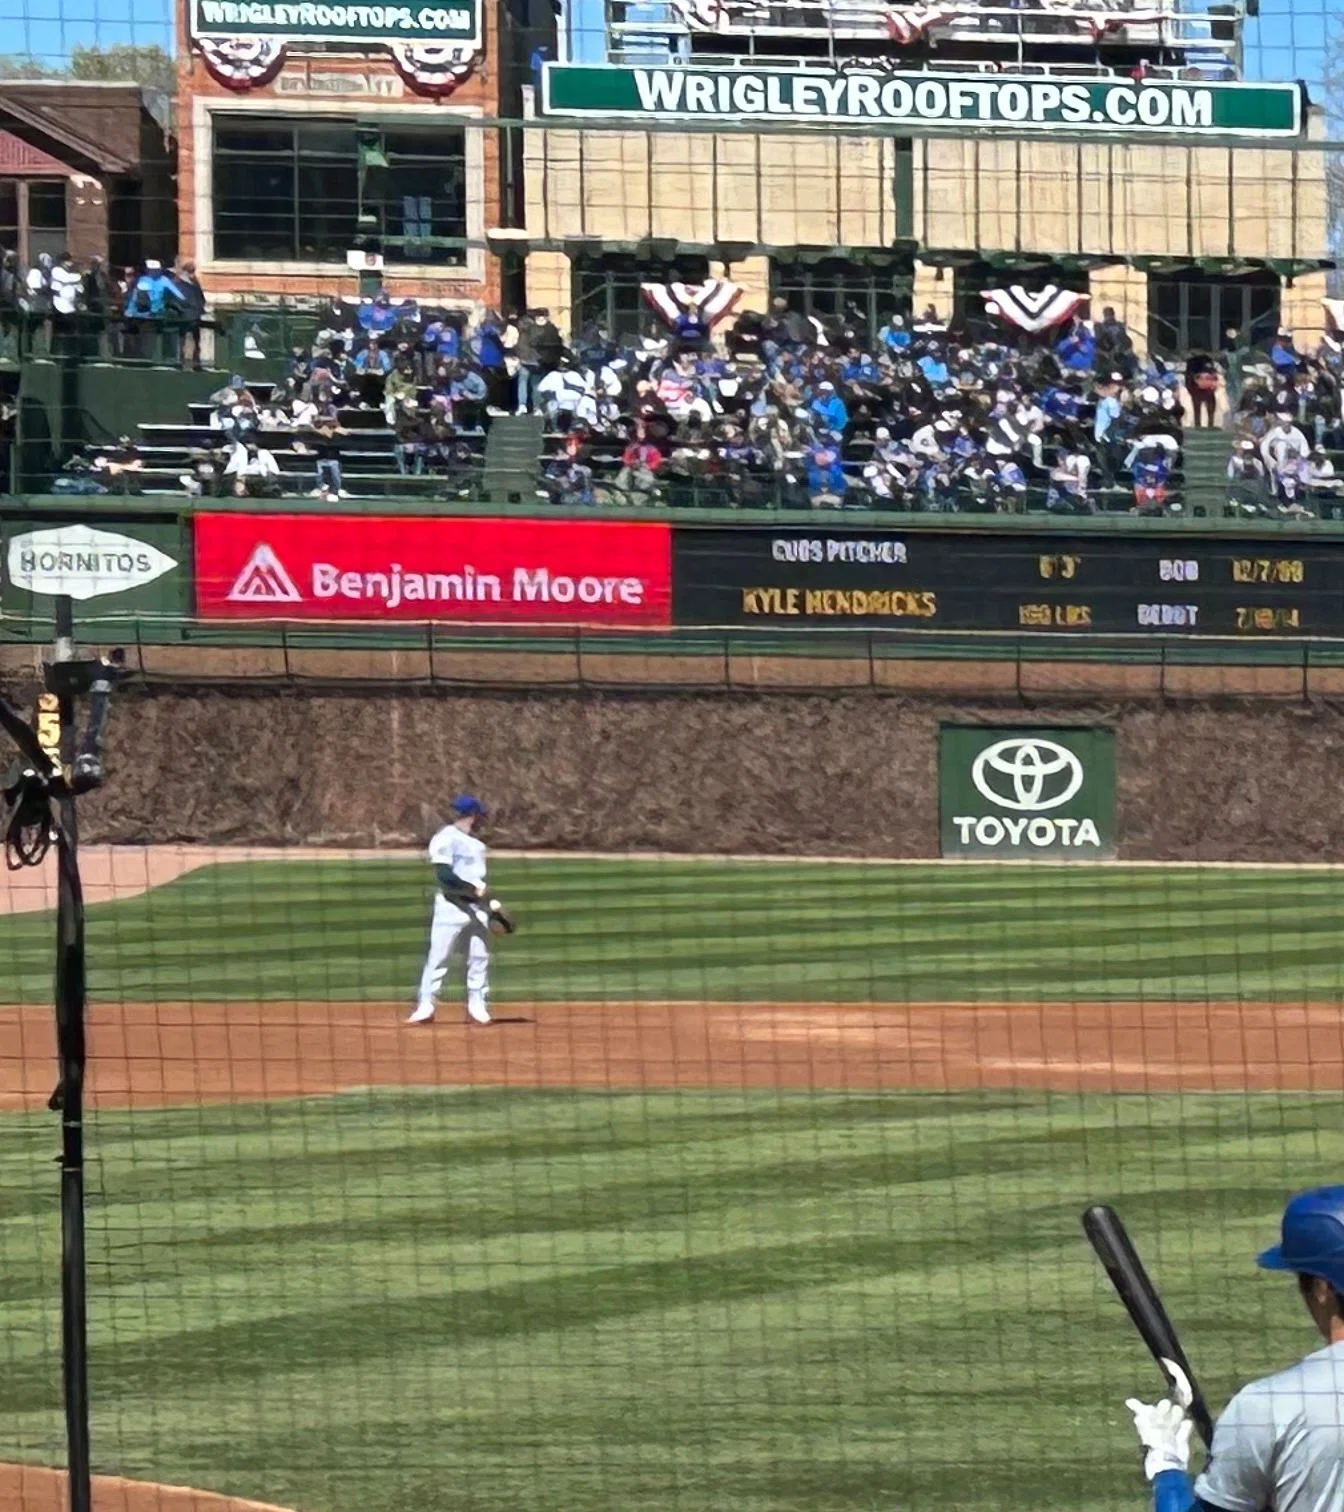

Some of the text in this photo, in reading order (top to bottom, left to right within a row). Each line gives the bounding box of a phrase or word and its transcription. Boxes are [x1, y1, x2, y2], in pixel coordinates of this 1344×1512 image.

[201, 2, 471, 30] WRIGLEYROOFTOPS.COM
[634, 69, 1213, 127] WRIGLEYROOFTOPS.COM
[20, 551, 152, 573] HORNITOS
[312, 561, 644, 608] Benjamin Moore
[742, 588, 800, 615] KYLE
[952, 815, 1101, 847] TOYOTA
